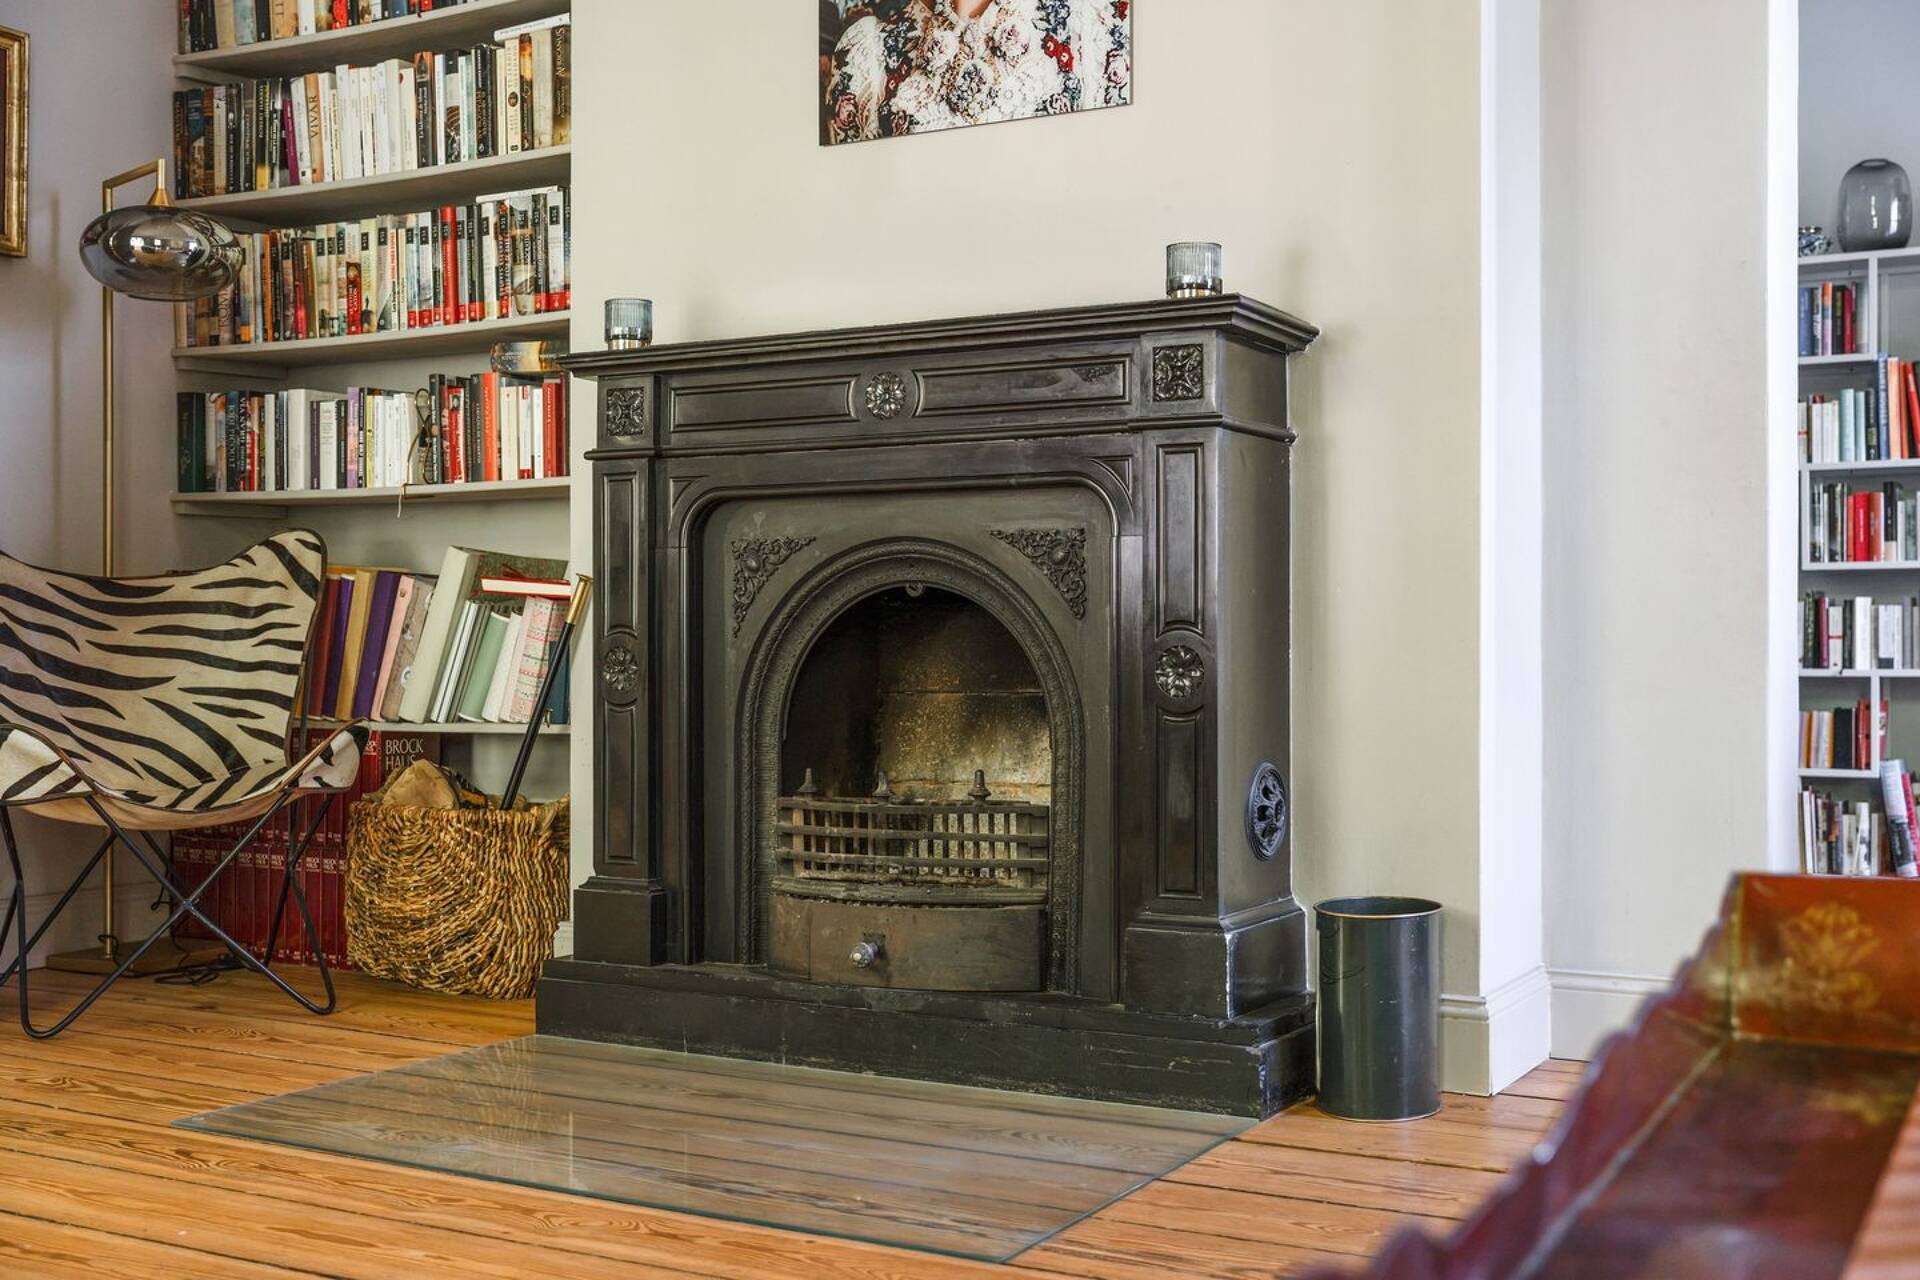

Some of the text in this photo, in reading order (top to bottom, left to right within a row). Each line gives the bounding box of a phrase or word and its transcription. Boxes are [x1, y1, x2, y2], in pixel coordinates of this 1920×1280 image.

[307, 95, 319, 139] VIVAR
[385, 738, 424, 755] BROCK
[385, 754, 416, 770] HAUS
